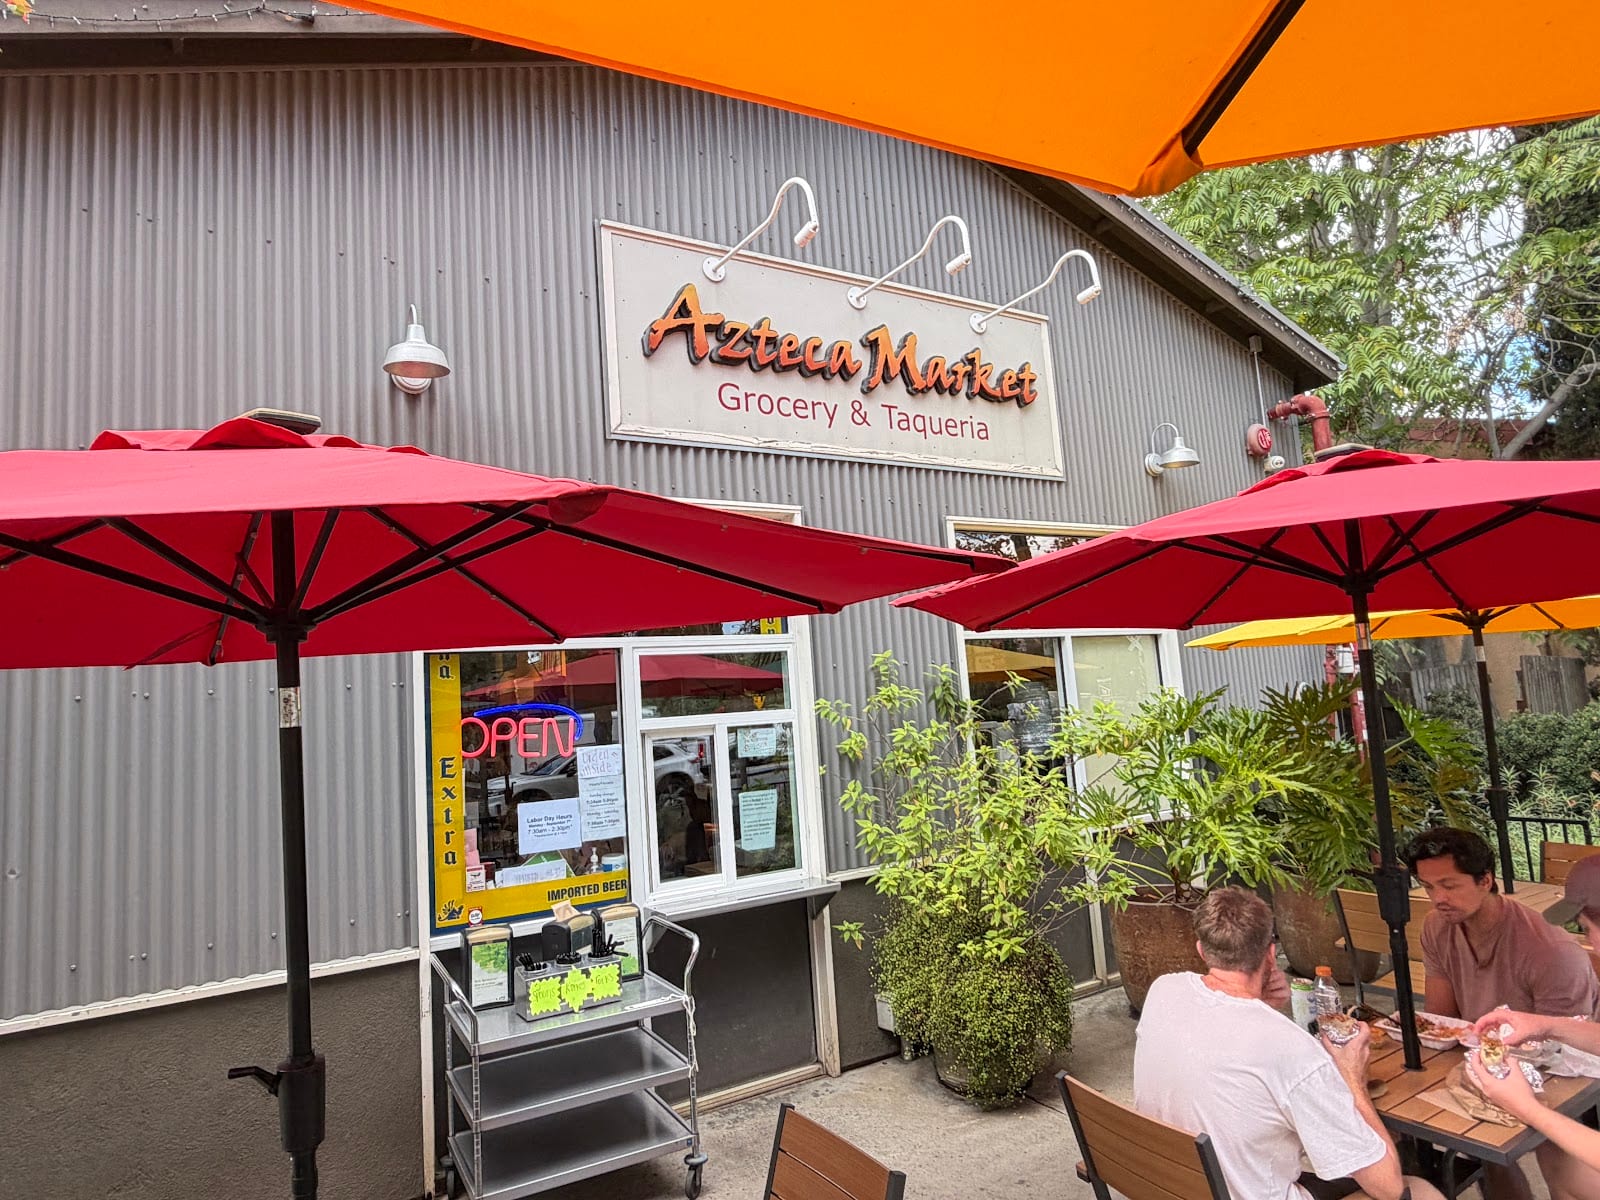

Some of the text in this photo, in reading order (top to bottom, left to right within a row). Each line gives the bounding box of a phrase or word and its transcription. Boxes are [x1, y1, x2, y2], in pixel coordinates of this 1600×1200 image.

[642, 282, 1038, 408] Azteca Market
[717, 383, 990, 441] Grocery & Taqueria
[461, 717, 575, 758] OPEN
[439, 756, 458, 865] Extra
[547, 879, 627, 901] IMPORTED BEER
